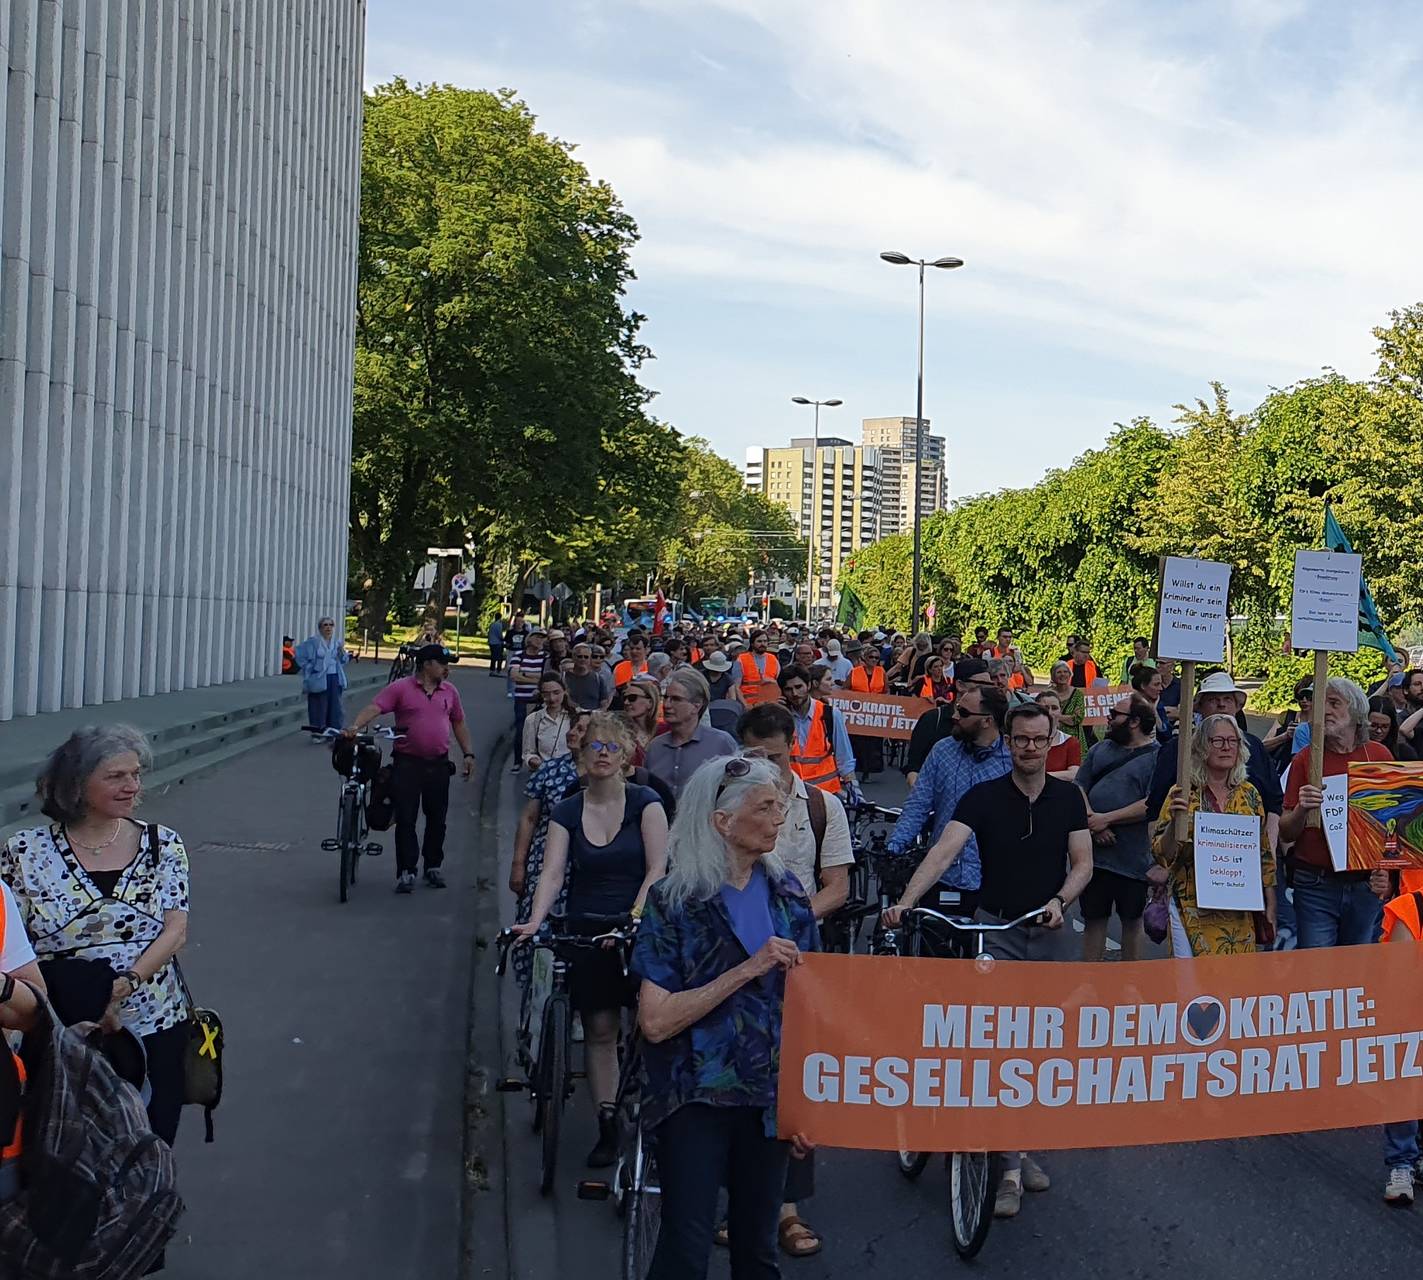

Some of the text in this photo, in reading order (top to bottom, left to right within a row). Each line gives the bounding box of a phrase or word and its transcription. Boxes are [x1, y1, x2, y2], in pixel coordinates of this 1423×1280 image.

[1171, 579, 1221, 592] Willst du ein
[1163, 592, 1204, 603] Krimineller
[1185, 607, 1198, 616] für
[1200, 611, 1222, 619] unser
[1171, 621, 1192, 630] Klima
[1195, 624, 1207, 632] ein
[1326, 794, 1345, 802] Weg
[1325, 806, 1344, 818] FDP
[1200, 825, 1254, 837] Klimaschützer
[1197, 839, 1257, 850] kriminalisieren?
[1211, 854, 1243, 863] DAS ist
[922, 1003, 1065, 1050] MEHR
[802, 1039, 1329, 1108] GESELLSCHAFTSRAT
